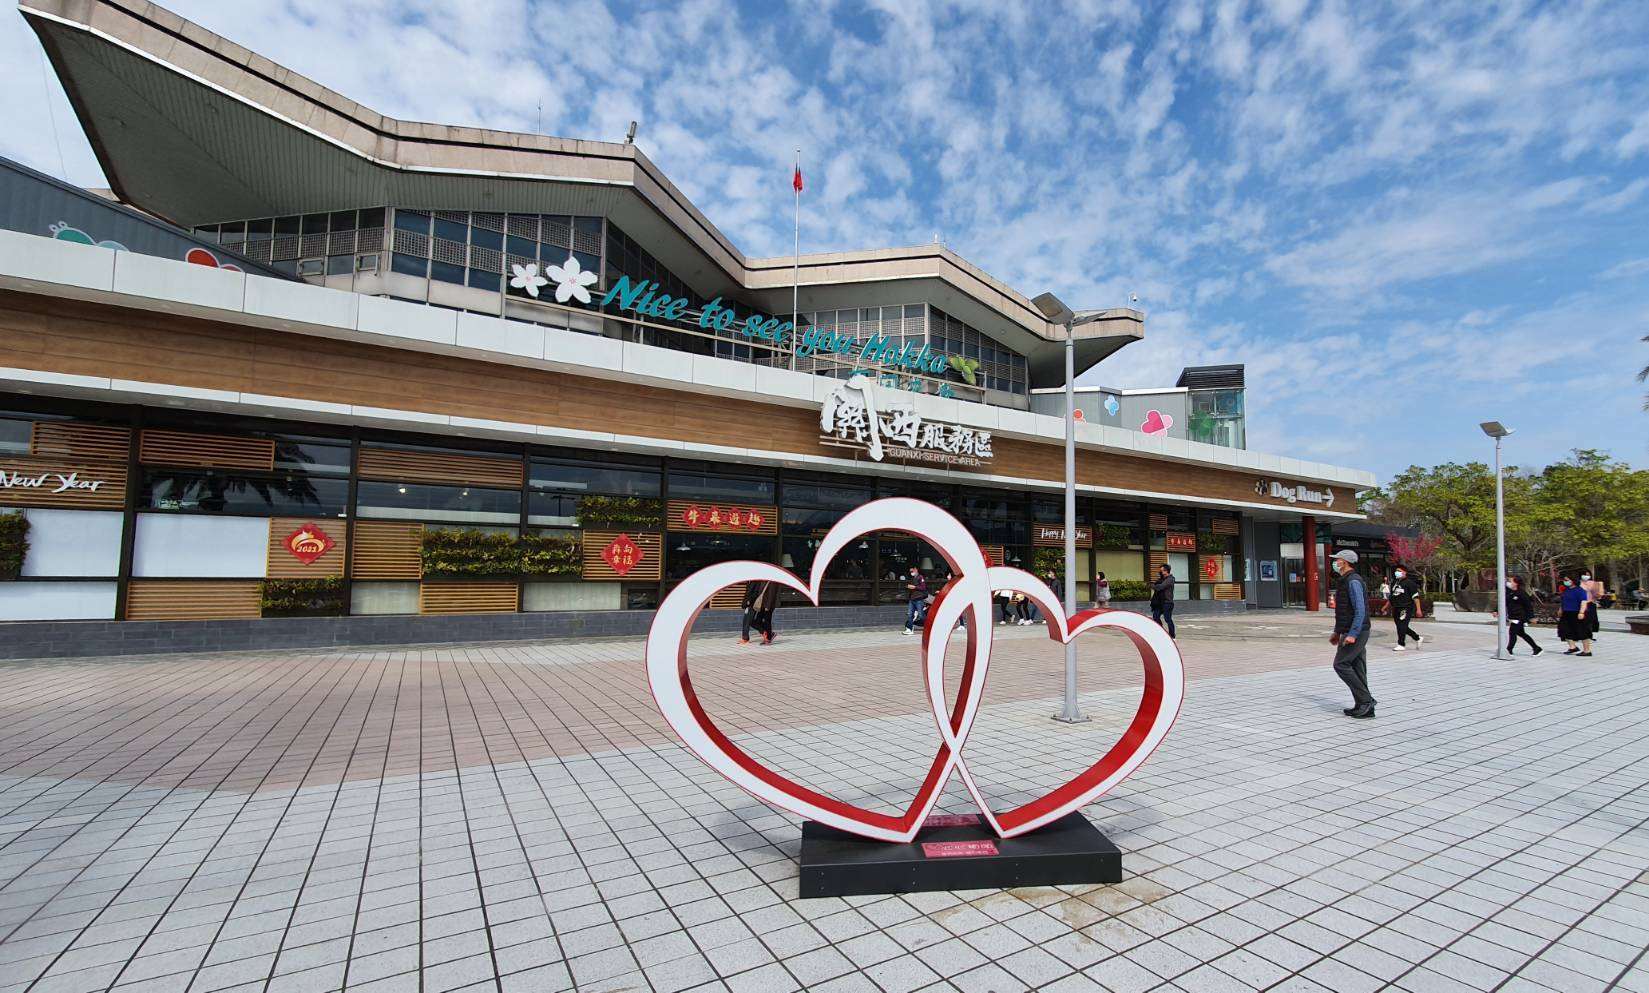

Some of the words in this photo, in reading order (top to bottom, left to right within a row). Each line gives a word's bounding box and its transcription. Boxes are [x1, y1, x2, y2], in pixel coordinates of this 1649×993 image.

[602, 275, 688, 320] Nice
[699, 297, 735, 331] to
[742, 315, 793, 342] see
[796, 325, 857, 358] you
[860, 332, 948, 374] Hakka
[888, 447, 922, 460] GUANXI
[923, 452, 958, 464] SERVICE
[959, 457, 981, 467] AREA
[0, 470, 50, 488] New
[51, 472, 106, 493] Year
[1270, 481, 1297, 503] Dog
[1296, 485, 1322, 503] Run
